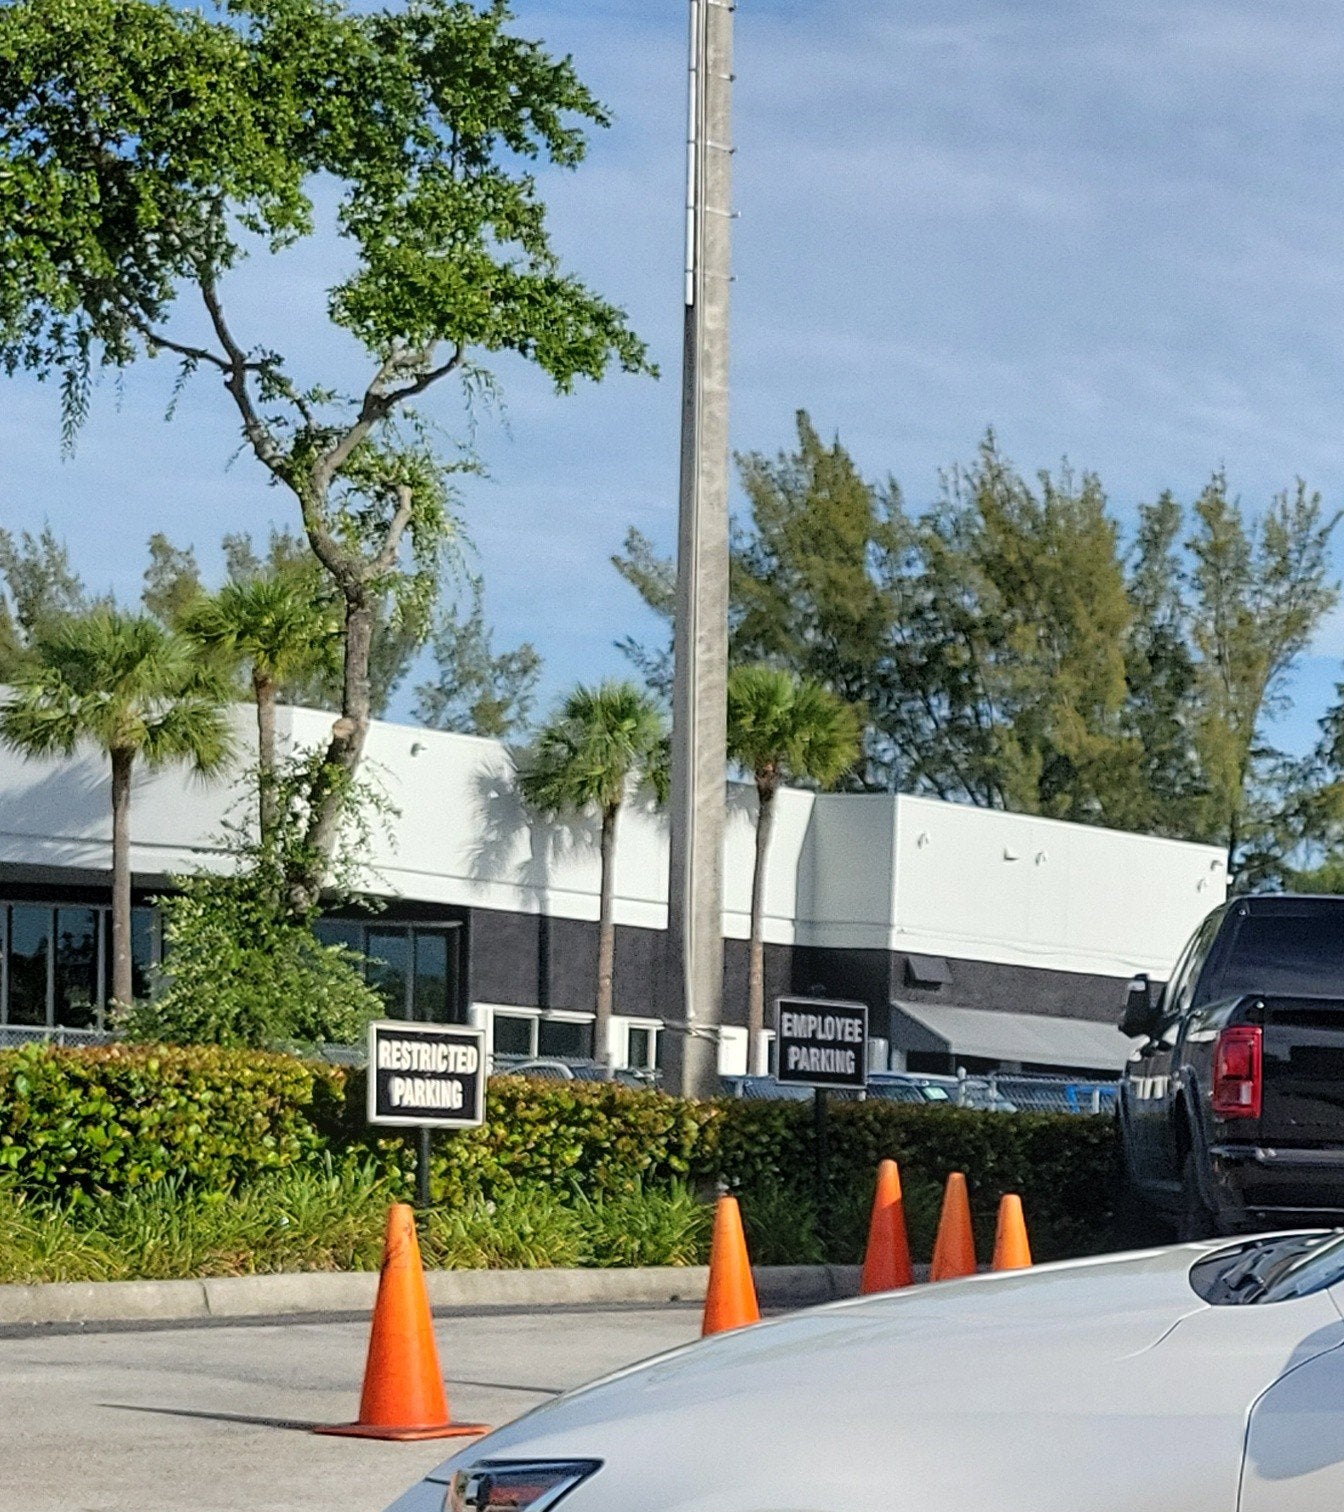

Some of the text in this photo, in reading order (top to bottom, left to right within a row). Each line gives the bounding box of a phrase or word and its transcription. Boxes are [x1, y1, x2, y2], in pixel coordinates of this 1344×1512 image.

[782, 1012, 863, 1043] EMPLOYEE
[378, 1039, 479, 1075] RESTRICTED
[788, 1046, 856, 1074] PARKING
[389, 1076, 464, 1110] PARKING
